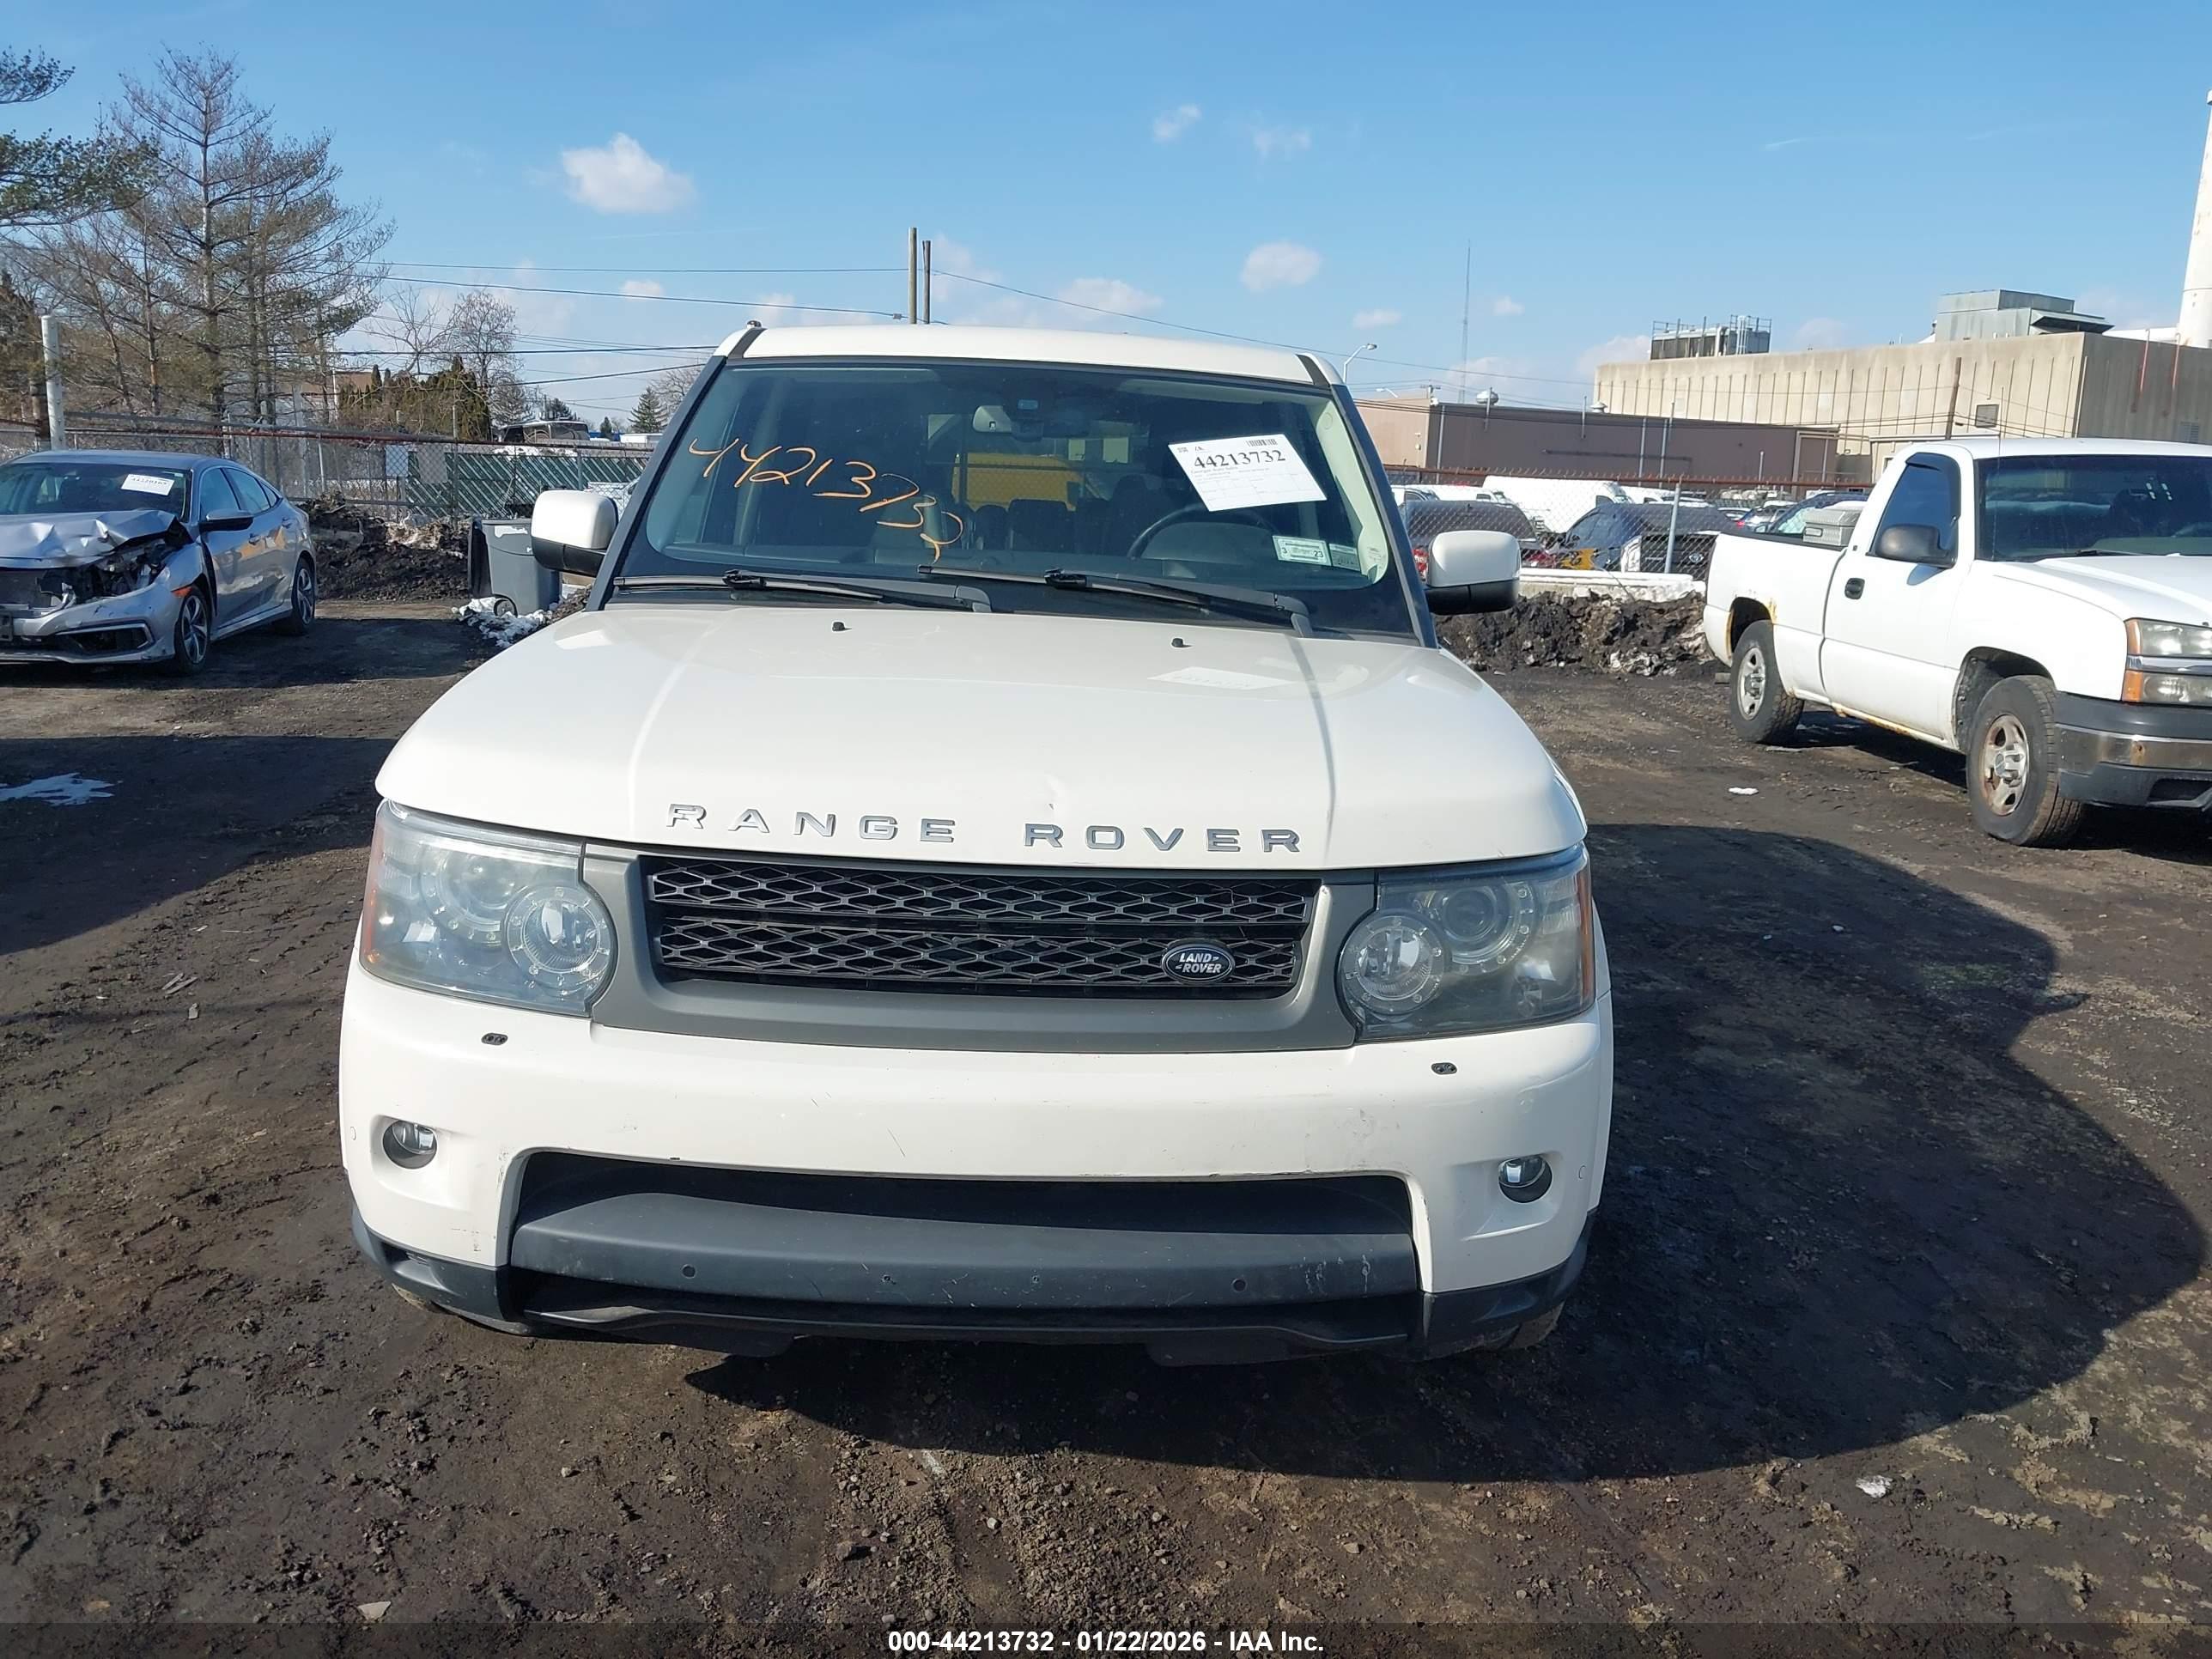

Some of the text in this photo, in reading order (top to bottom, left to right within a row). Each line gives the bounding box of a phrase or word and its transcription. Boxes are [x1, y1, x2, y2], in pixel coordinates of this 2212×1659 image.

[1194, 449, 1286, 469] 44213732
[666, 803, 1303, 854] RANGE ROVER
[1179, 952, 1212, 963] LAND
[1182, 963, 1222, 973] ROVER
